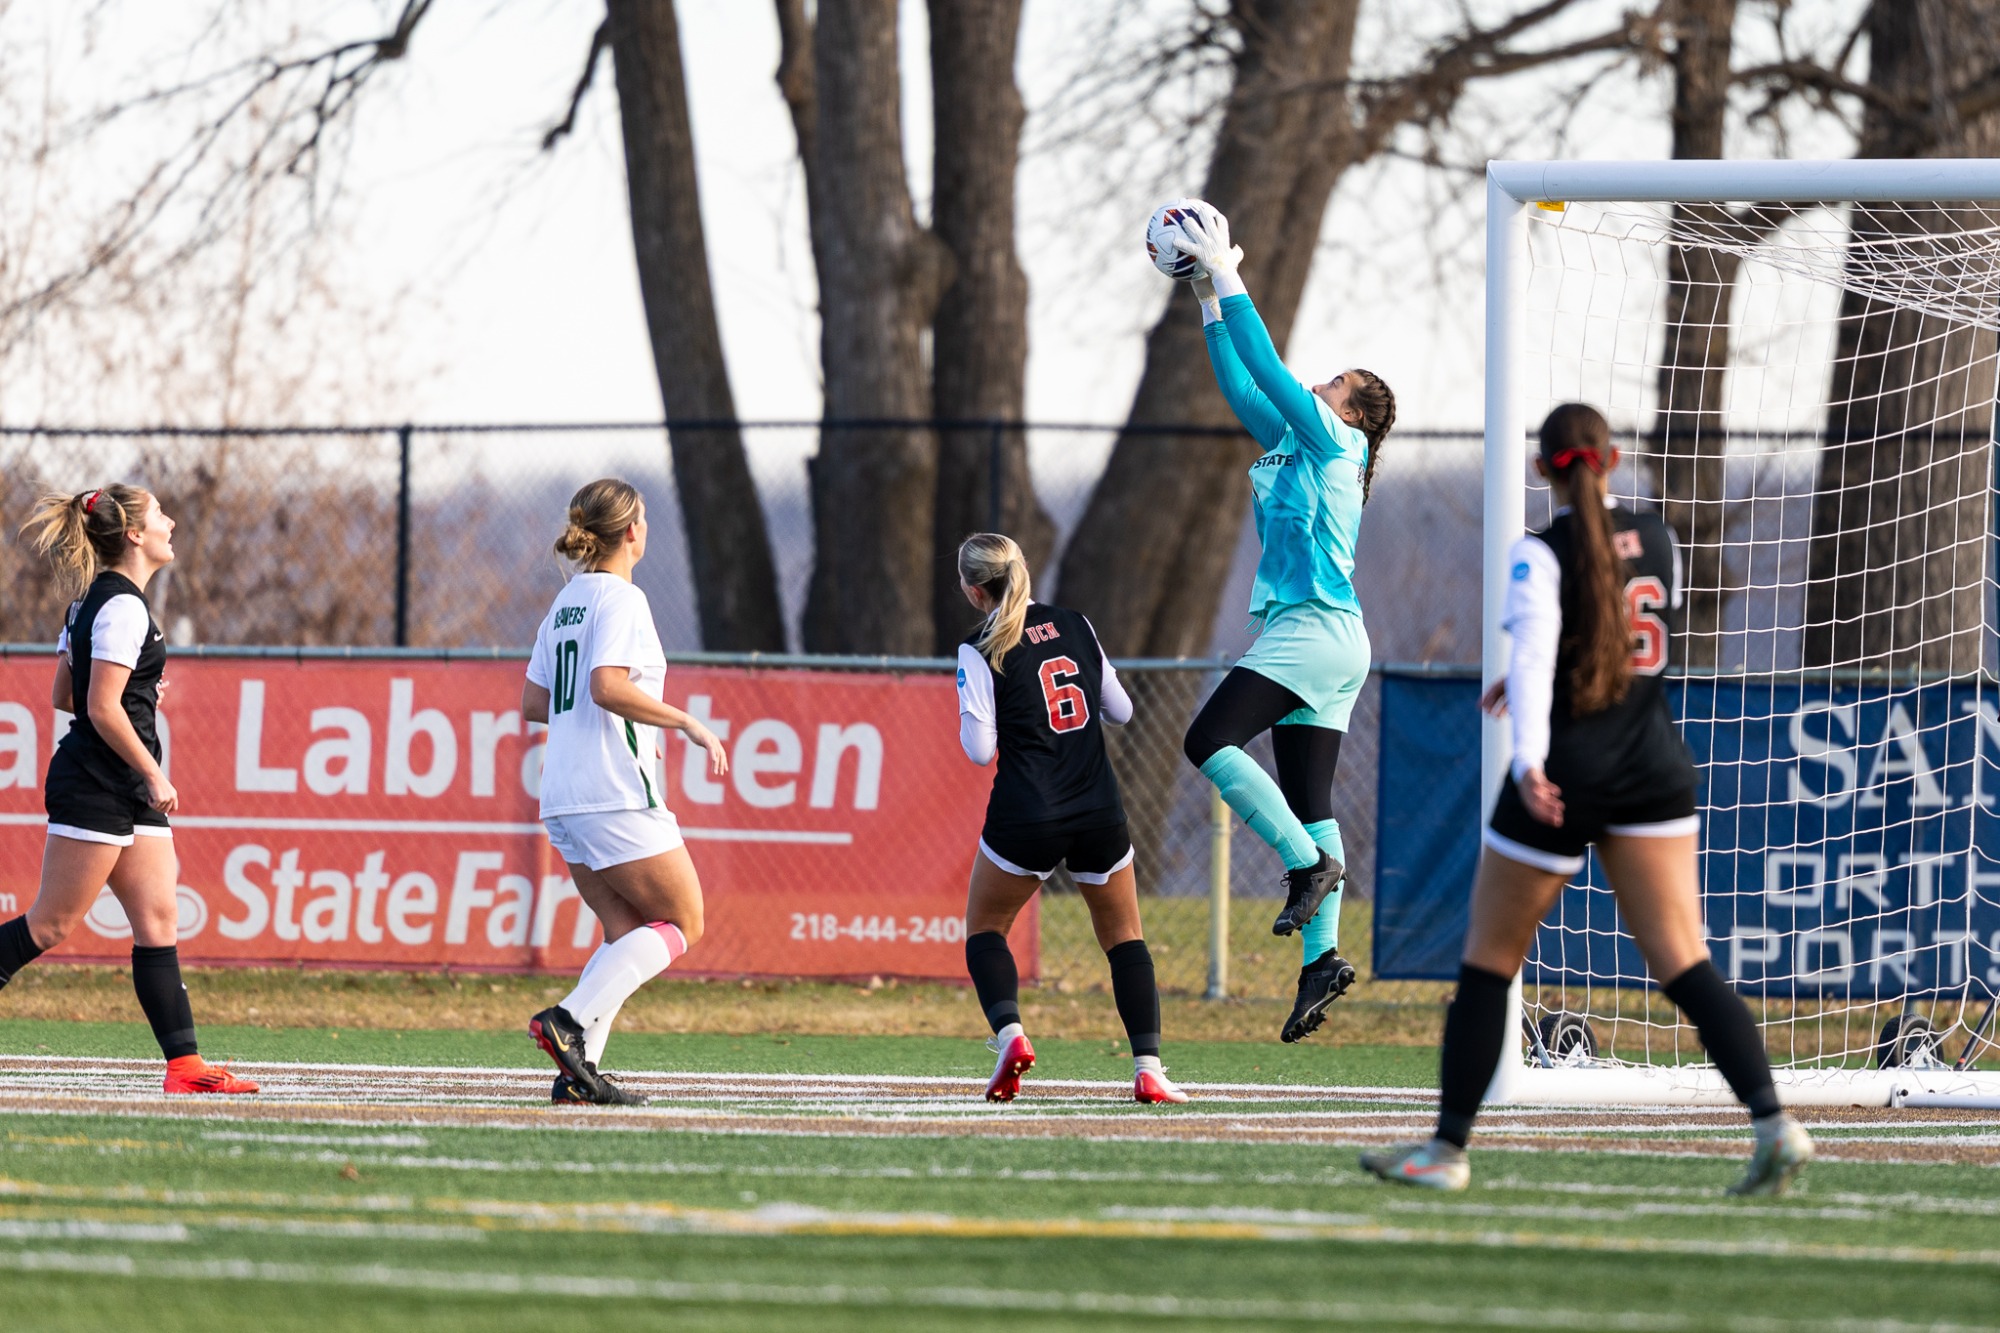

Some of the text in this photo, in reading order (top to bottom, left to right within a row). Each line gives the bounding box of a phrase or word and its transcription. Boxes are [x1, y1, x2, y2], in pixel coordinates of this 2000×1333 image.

[1253, 453, 1295, 470] STATE
[1025, 621, 1060, 645] UCM
[554, 638, 578, 715] 10
[1037, 654, 1090, 734] 6
[235, 677, 884, 811] Labrten
[790, 911, 967, 943] 218-444-240
